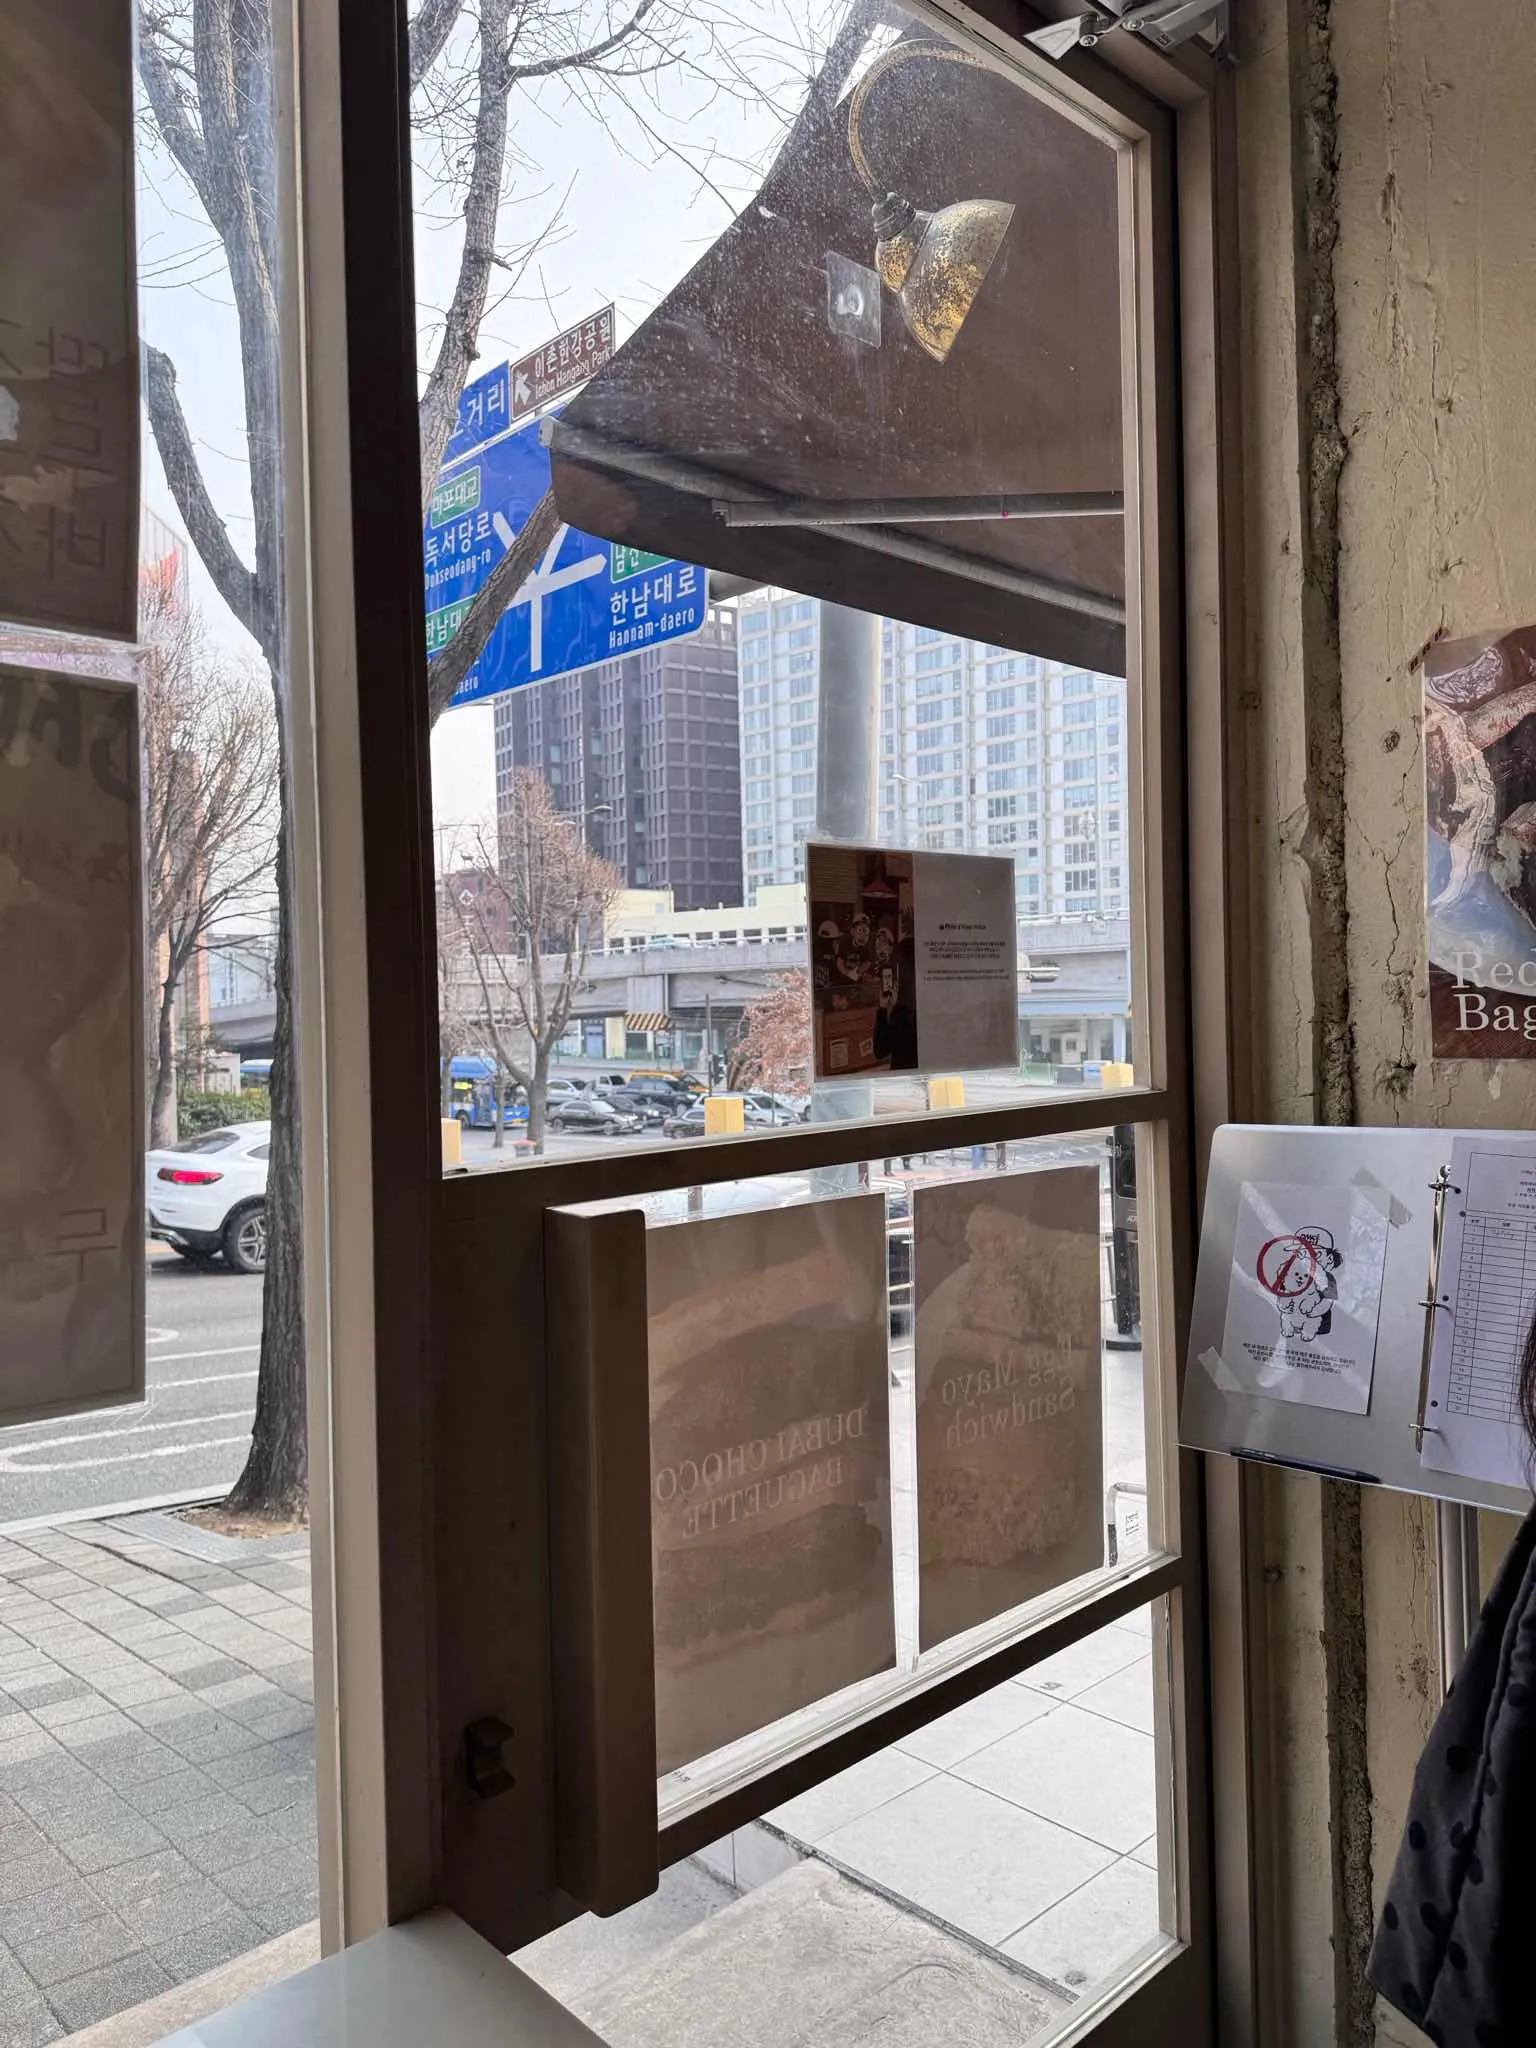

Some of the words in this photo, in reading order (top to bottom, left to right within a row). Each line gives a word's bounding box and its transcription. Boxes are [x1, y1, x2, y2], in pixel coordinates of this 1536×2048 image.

[534, 312, 611, 378] 이촌한강공원
[535, 379, 555, 399] Ichon
[556, 359, 589, 388] Hangang
[592, 346, 611, 367] Park
[431, 476, 479, 517] 마포대교
[424, 511, 491, 569] 독서당로
[609, 564, 697, 626] 한남대로
[425, 605, 471, 646] 한남대
[608, 607, 695, 649] Hannam-daero
